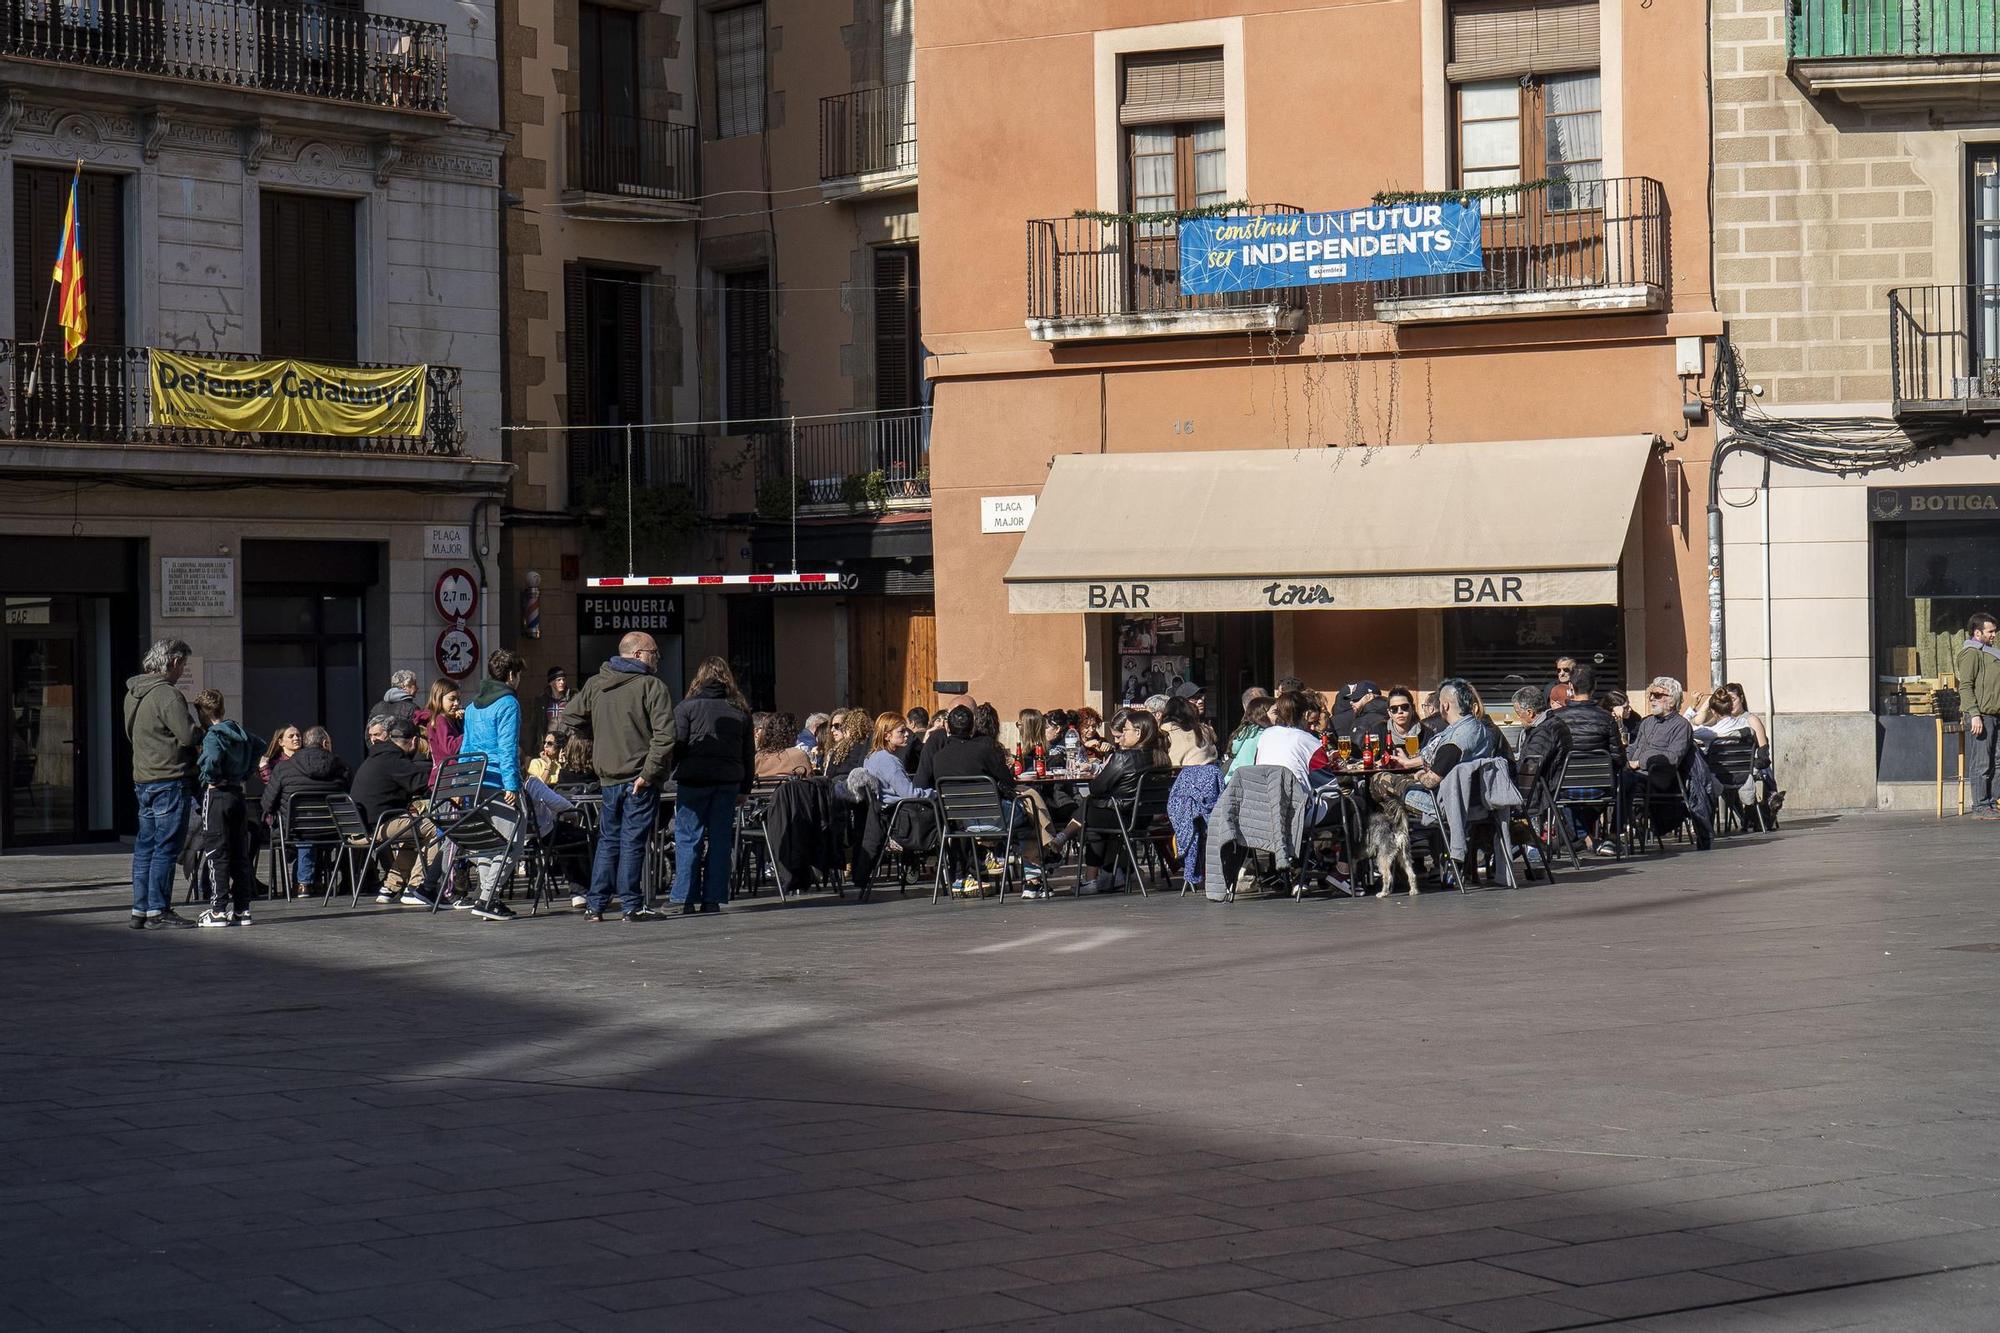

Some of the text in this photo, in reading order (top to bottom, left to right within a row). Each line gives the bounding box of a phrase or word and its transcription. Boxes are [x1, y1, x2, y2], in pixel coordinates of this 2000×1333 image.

[1306, 214, 1345, 236] UN
[1350, 205, 1442, 233] FUTUR
[1208, 230, 1453, 268] ser INDEPENDENTS
[158, 361, 417, 410] Defensa Catalunya!
[1910, 495, 1997, 511] BOTIGA
[995, 517, 1024, 527] MAJOR
[432, 544, 462, 554] MAJOR
[443, 591, 456, 603] 2,7
[1088, 584, 1150, 608] BAR
[1454, 577, 1524, 602] BAR
[585, 600, 675, 613] PELUQUERIA
[594, 616, 668, 629] B-BARBER
[450, 644, 461, 661] 2
